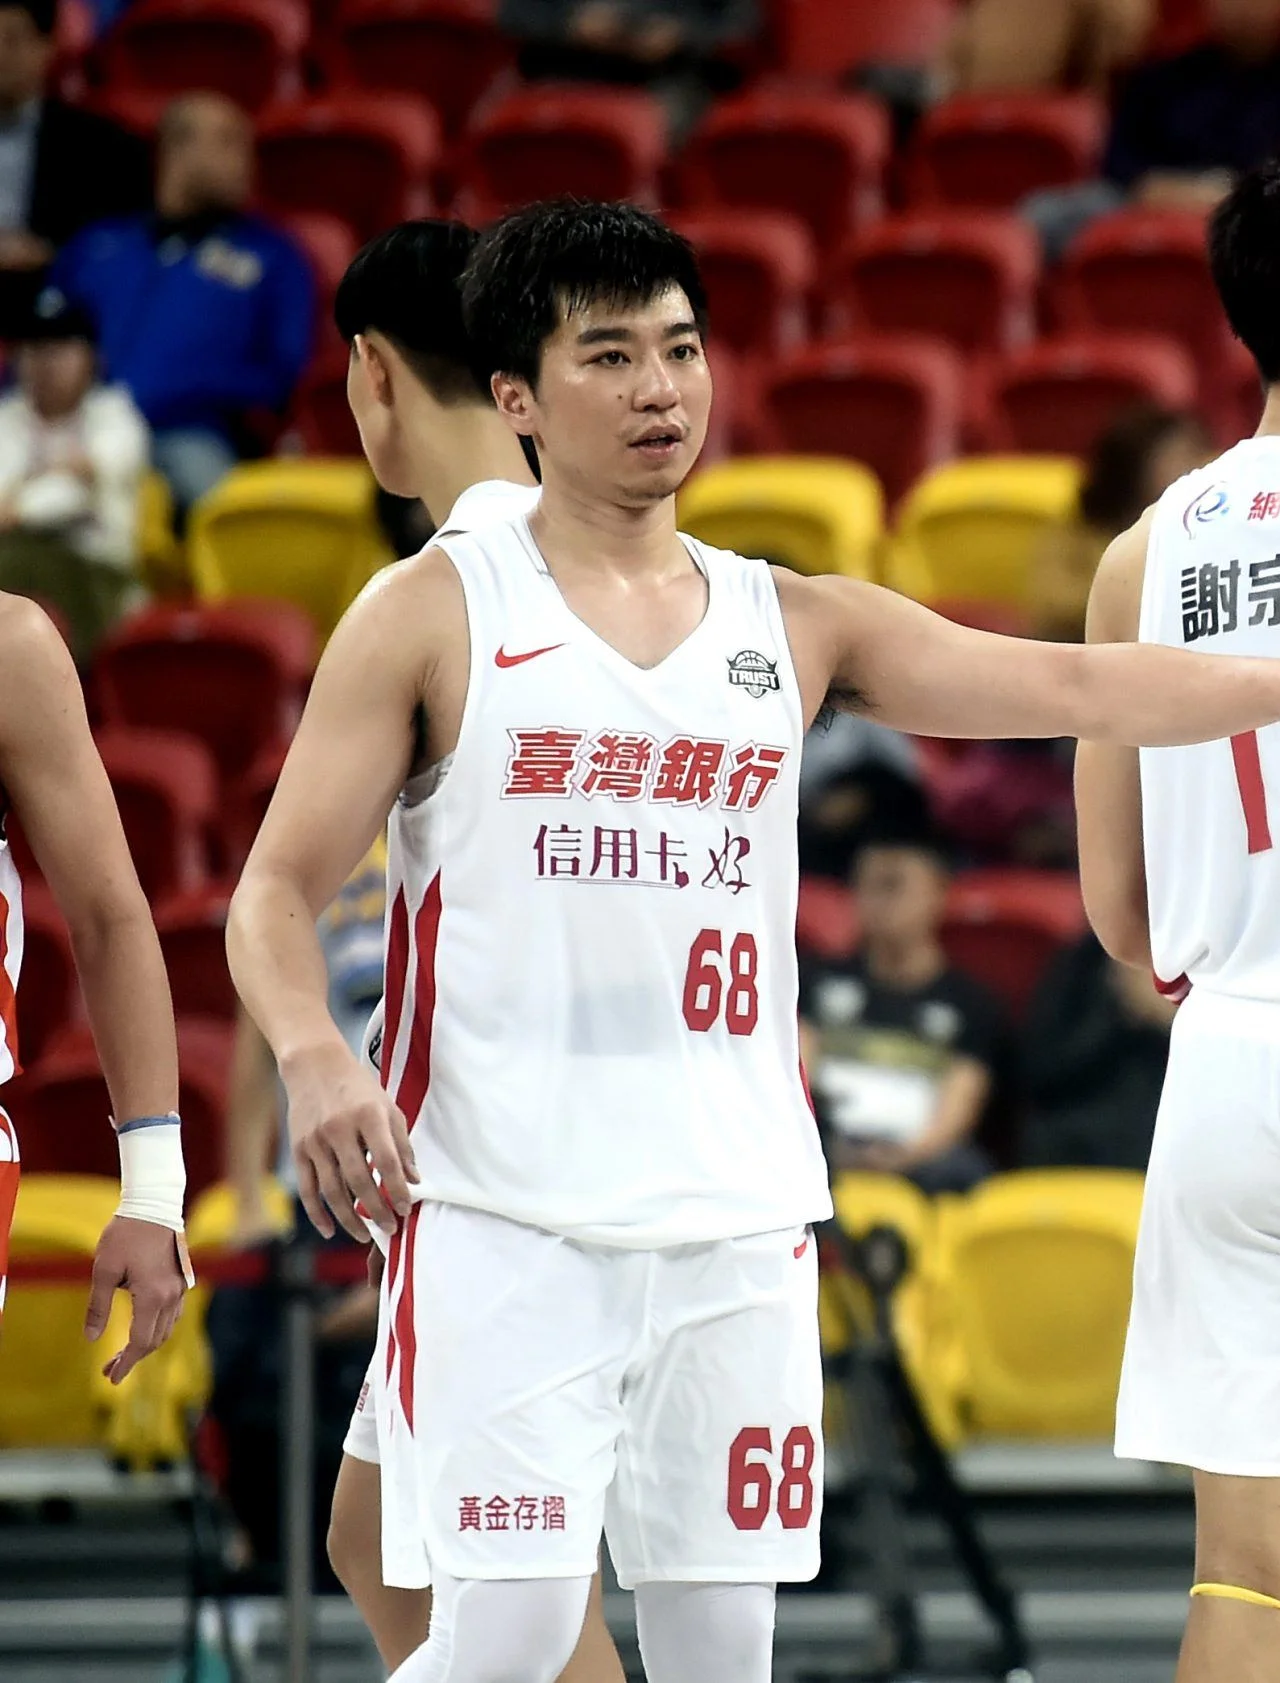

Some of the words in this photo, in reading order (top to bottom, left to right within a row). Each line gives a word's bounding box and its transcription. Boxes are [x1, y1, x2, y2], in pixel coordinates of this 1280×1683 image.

[729, 669, 778, 689] TRUST
[504, 730, 786, 811] 臺灣銀行
[682, 928, 758, 1036] 68
[459, 1495, 565, 1531] 黃金存摺
[727, 1425, 815, 1531] 68
